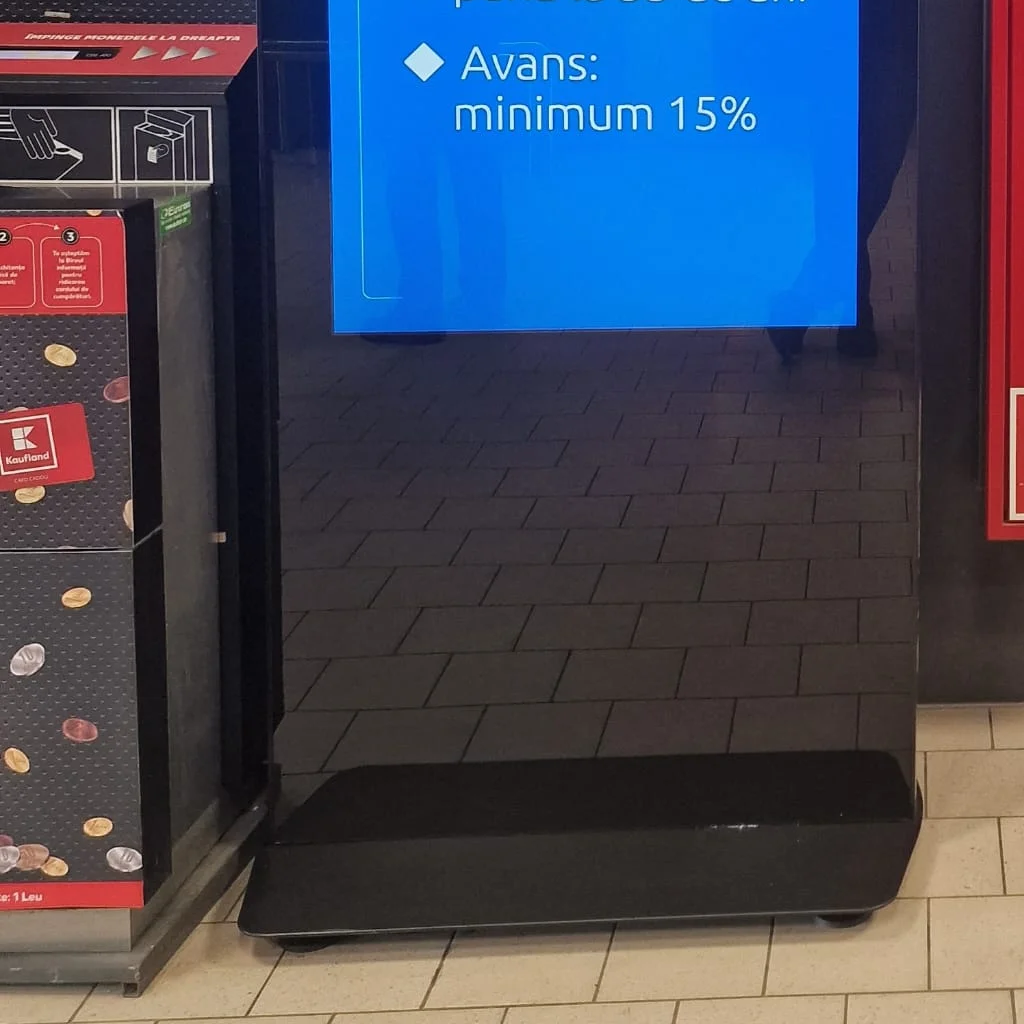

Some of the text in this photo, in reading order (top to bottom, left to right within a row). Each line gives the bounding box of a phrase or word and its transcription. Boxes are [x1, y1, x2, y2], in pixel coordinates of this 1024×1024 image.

[84, 34, 157, 42] MONEDELE
[179, 35, 241, 43] DREAPTA
[461, 46, 598, 82] Avans:
[454, 95, 758, 132] minimum 15%
[66, 231, 75, 242] 3
[5, 450, 50, 465] Kaufland
[13, 892, 43, 902] 1 Leu
